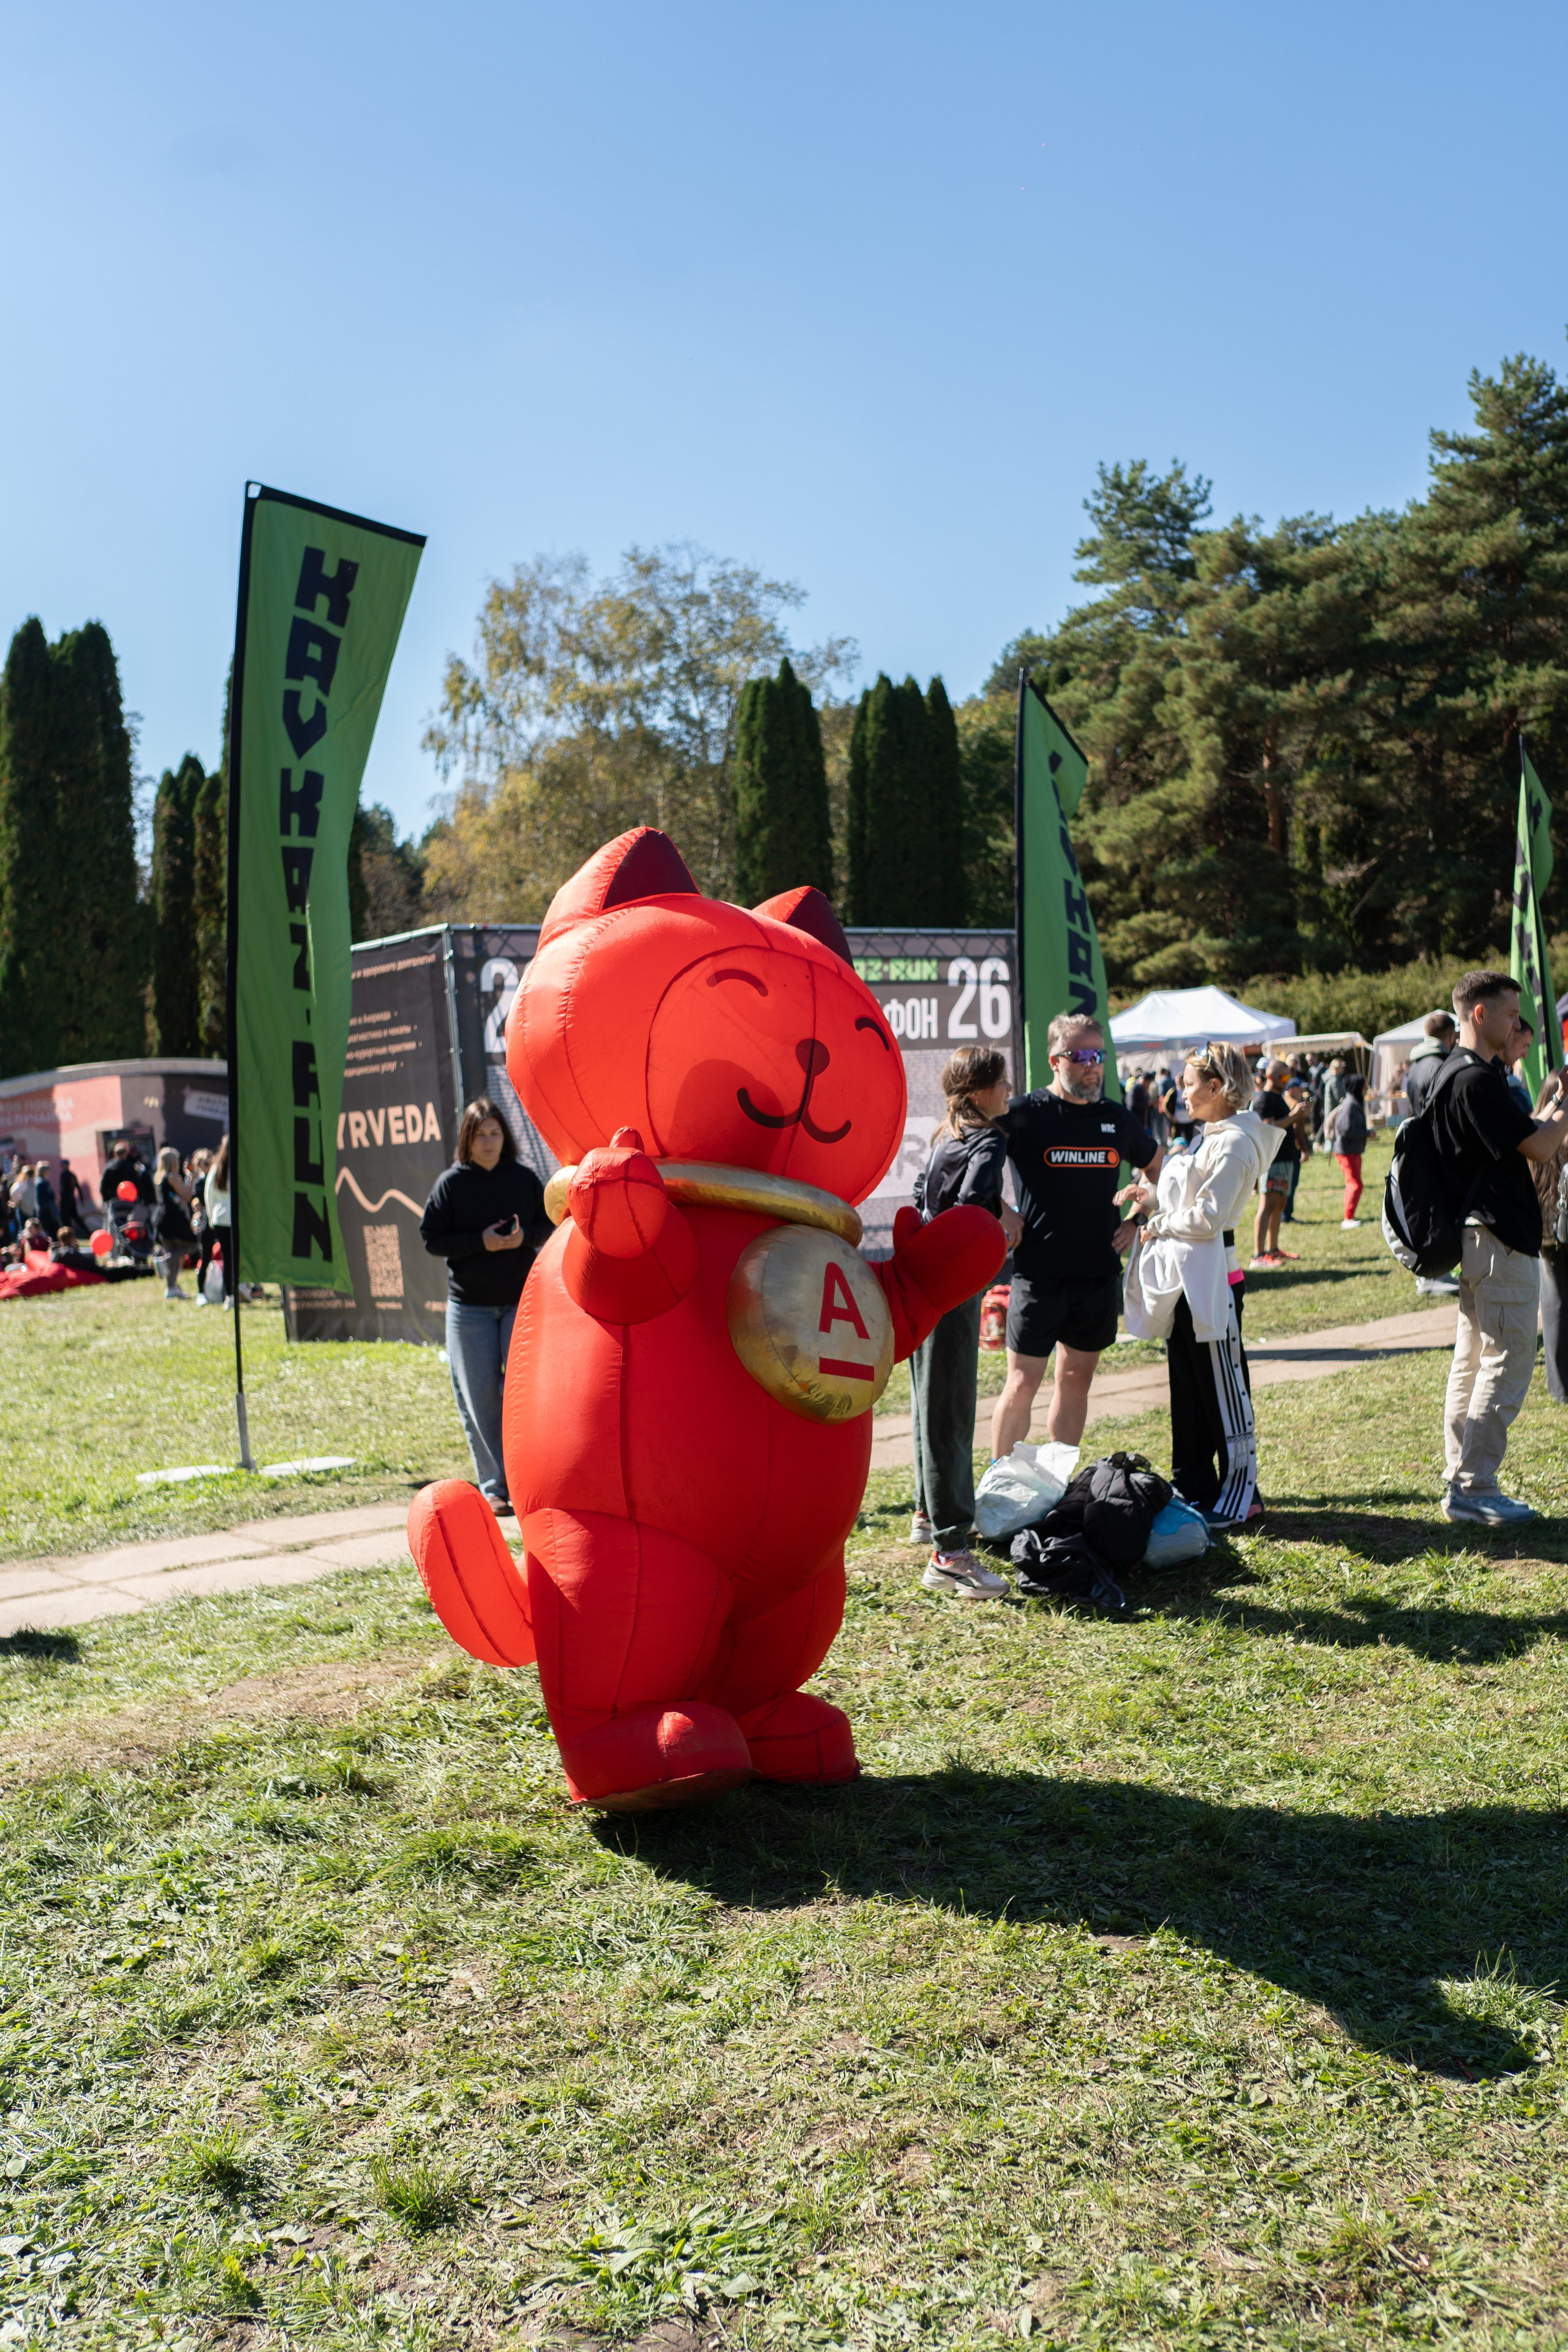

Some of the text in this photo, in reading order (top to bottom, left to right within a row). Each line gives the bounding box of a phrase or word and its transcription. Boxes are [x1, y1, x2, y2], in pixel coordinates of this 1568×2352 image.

[948, 956, 1011, 1039] 26
[878, 997, 938, 1040] ФОН
[1101, 1123, 1116, 1133] WRC
[1050, 1150, 1106, 1163] WINLINE
[819, 1262, 870, 1340] A
[1227, 1432, 1253, 1443] adidas
